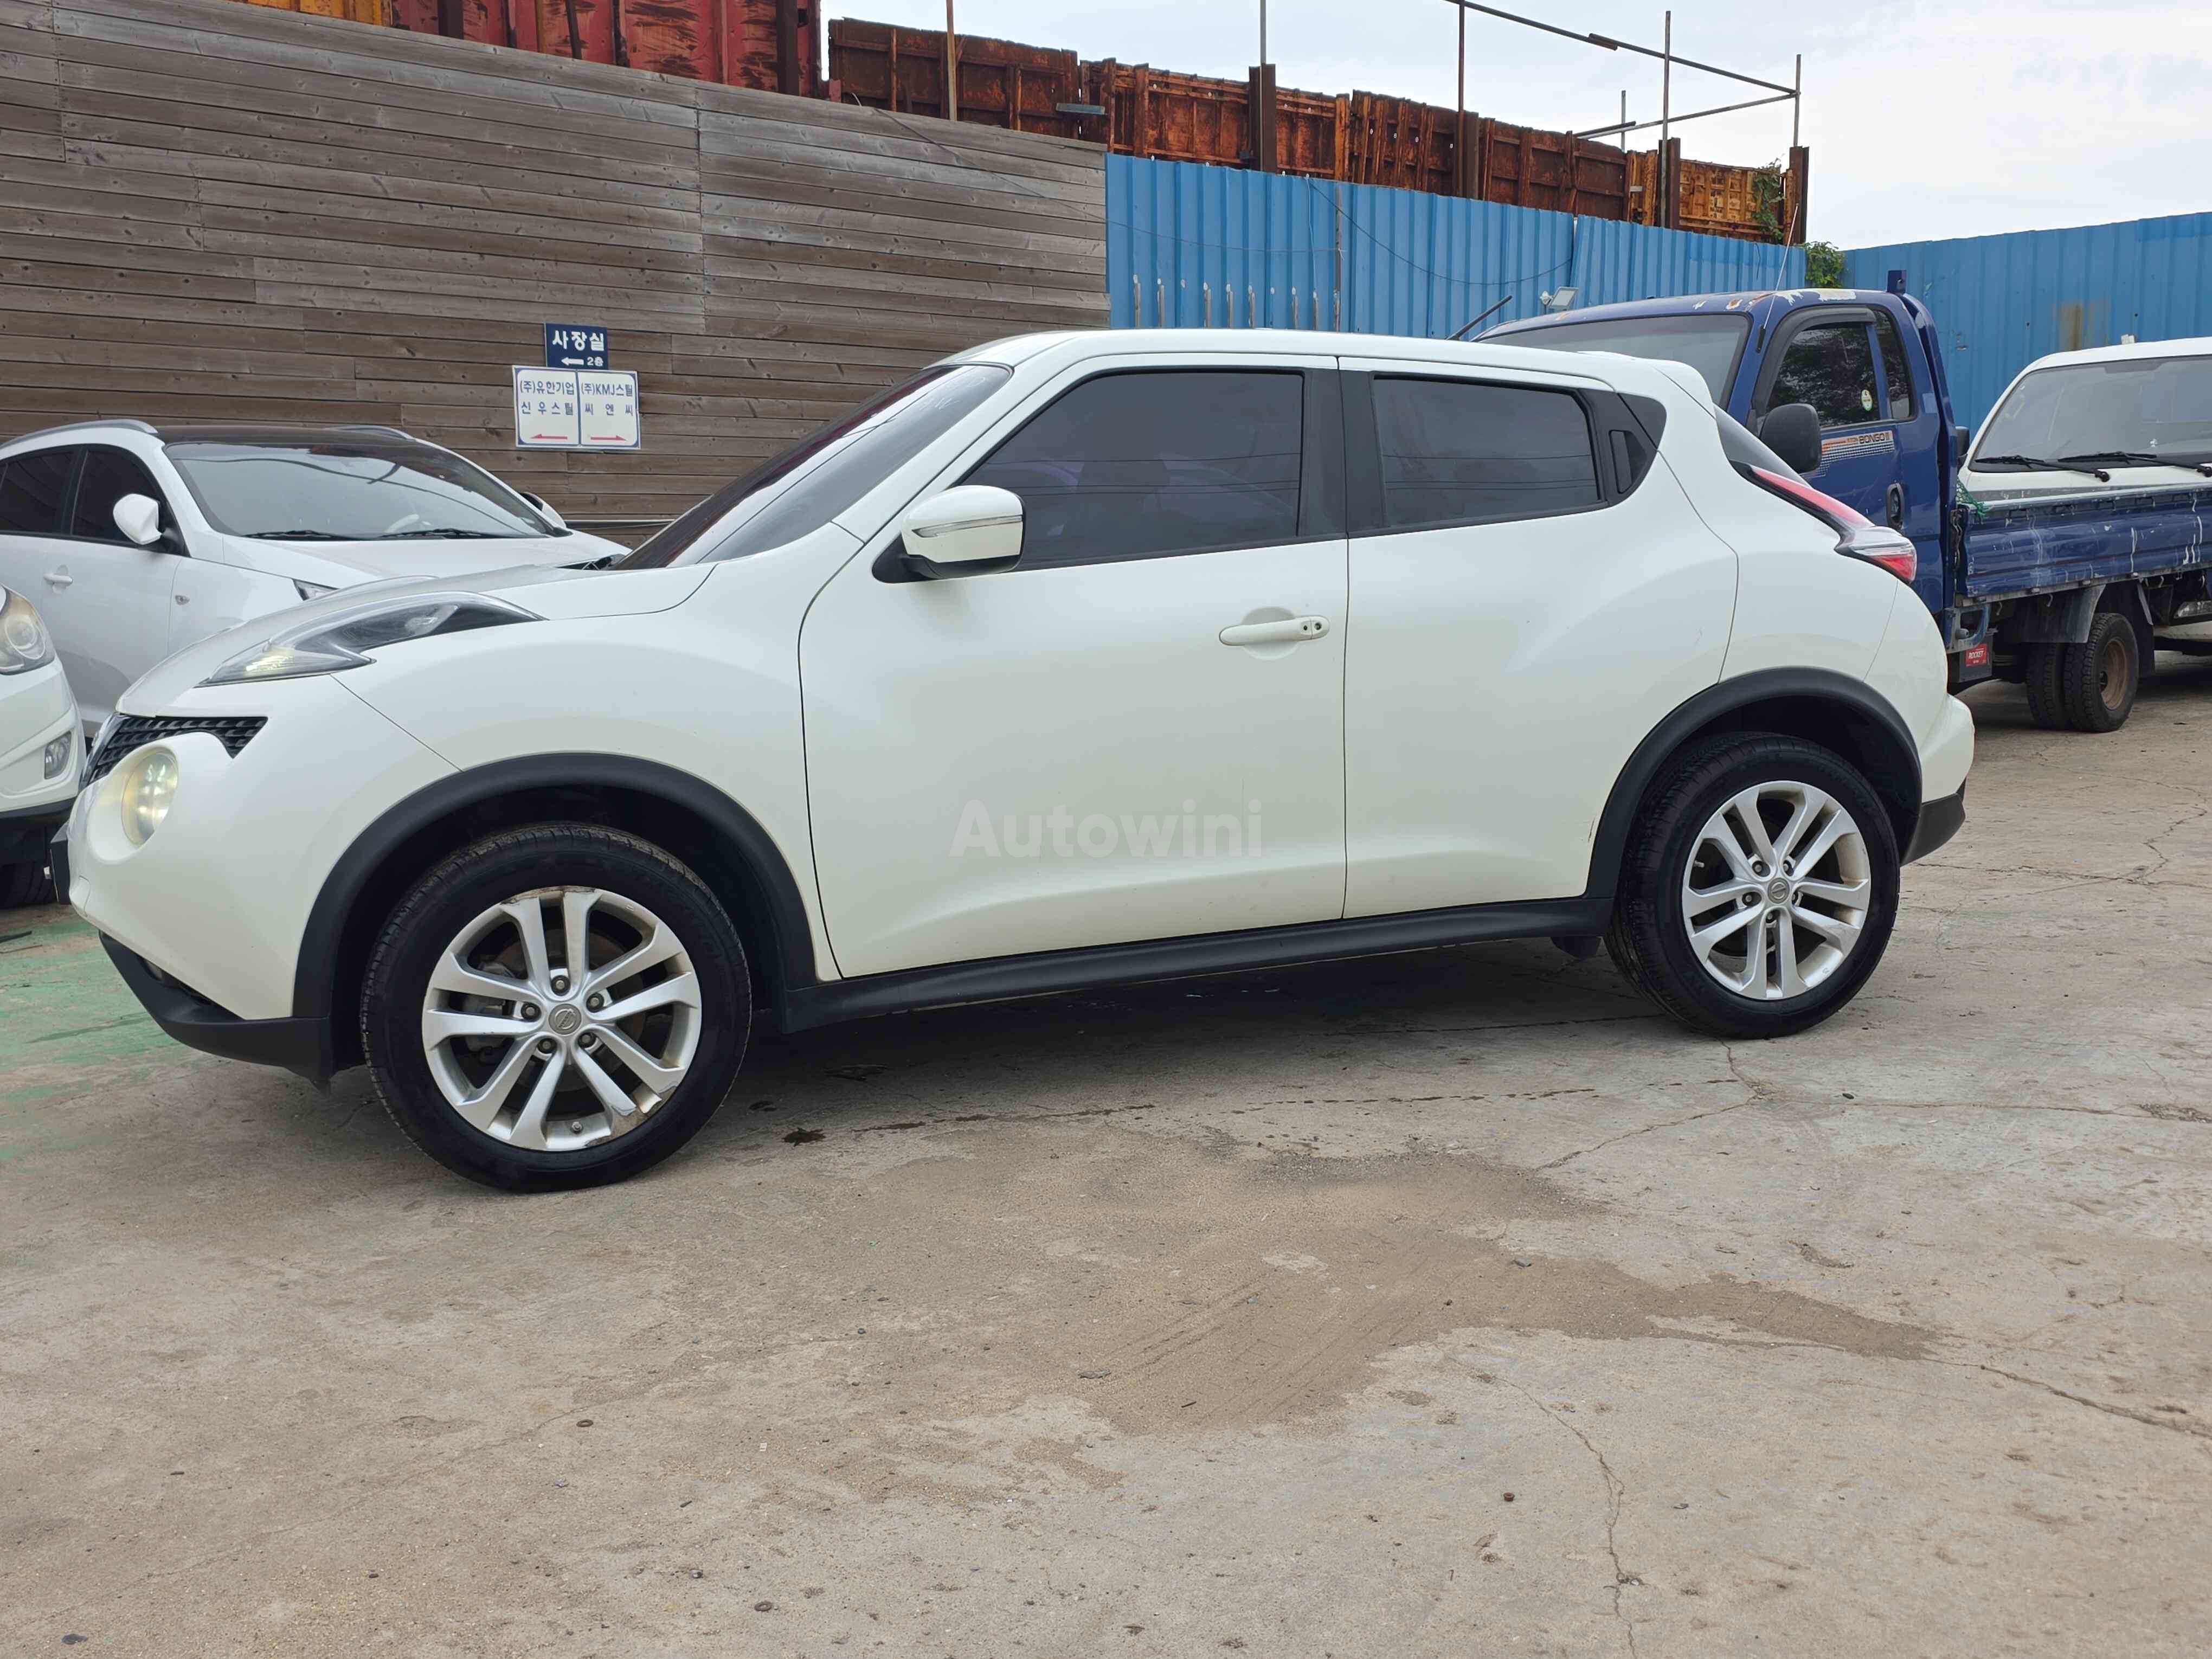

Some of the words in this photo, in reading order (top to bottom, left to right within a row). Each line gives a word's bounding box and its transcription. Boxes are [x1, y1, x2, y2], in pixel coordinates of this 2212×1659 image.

[552, 330, 605, 351] 사장실
[520, 380, 575, 395] (주)유한기업
[1859, 433, 1885, 444] BONGO
[1968, 650, 1984, 659] ROCKET
